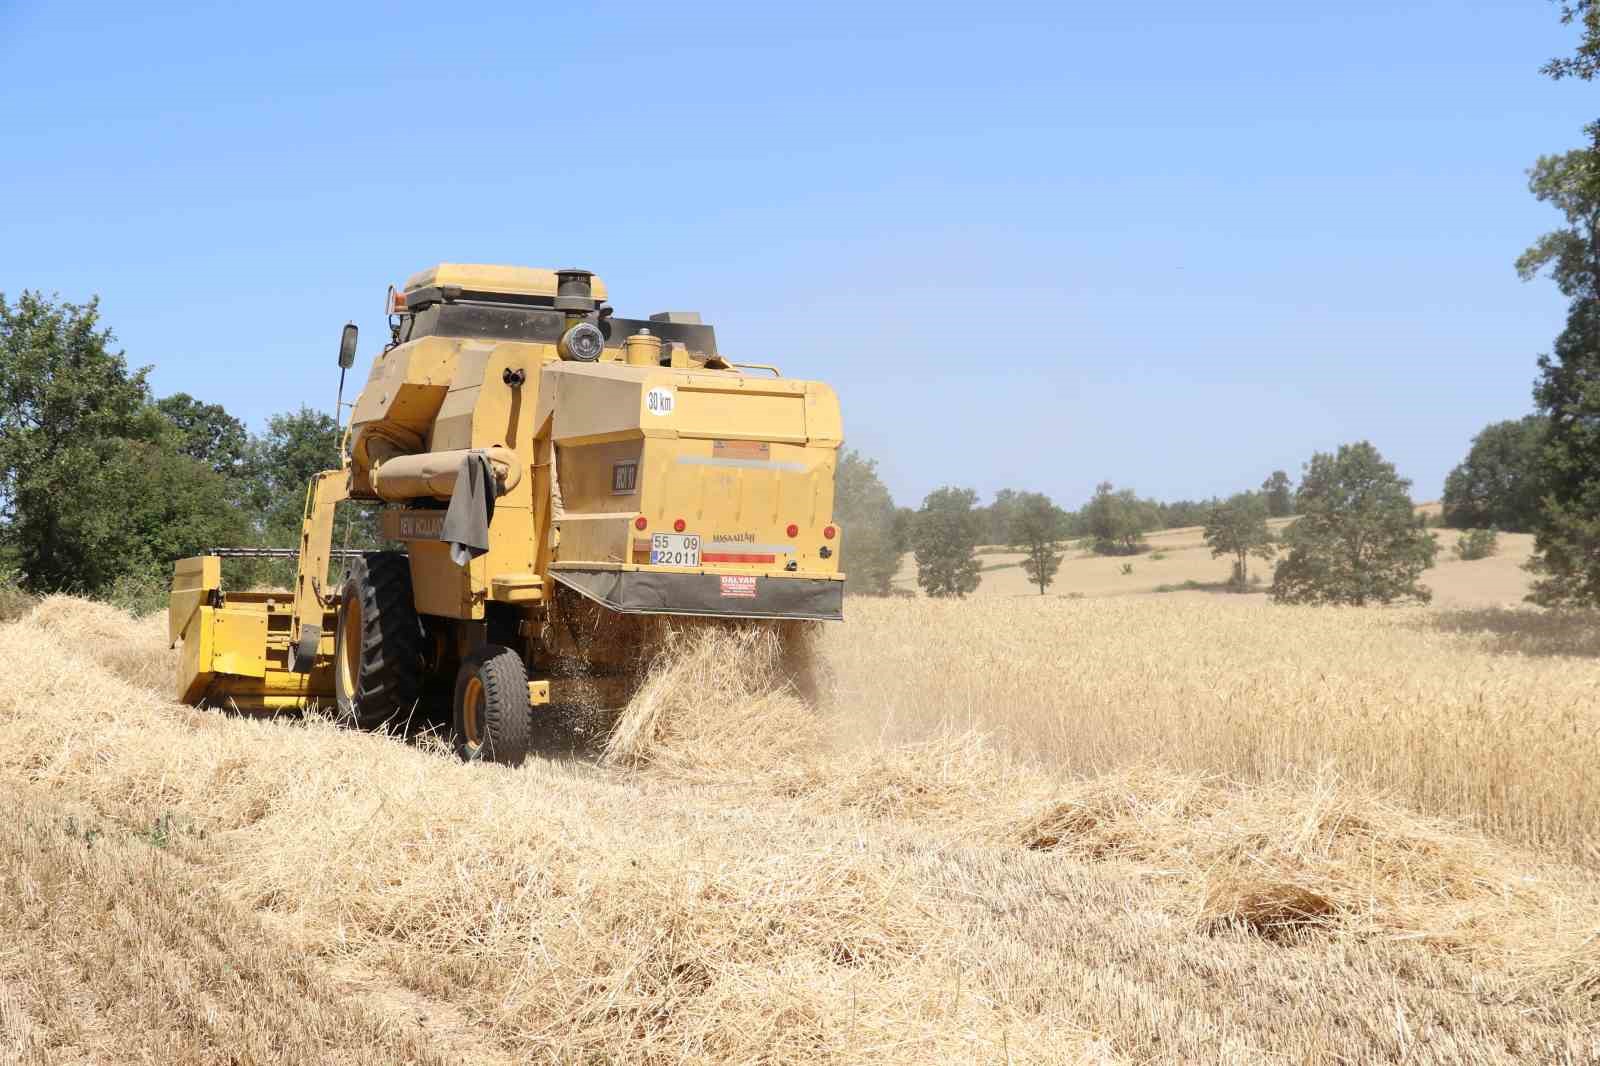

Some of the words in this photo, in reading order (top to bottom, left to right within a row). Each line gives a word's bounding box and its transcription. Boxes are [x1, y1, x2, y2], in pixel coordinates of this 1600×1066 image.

[648, 391, 658, 411] 30
[660, 391, 672, 411] km
[655, 535, 669, 549] 55
[683, 537, 698, 550] 09
[659, 551, 697, 565] 22011
[721, 576, 756, 585] DALYAN
